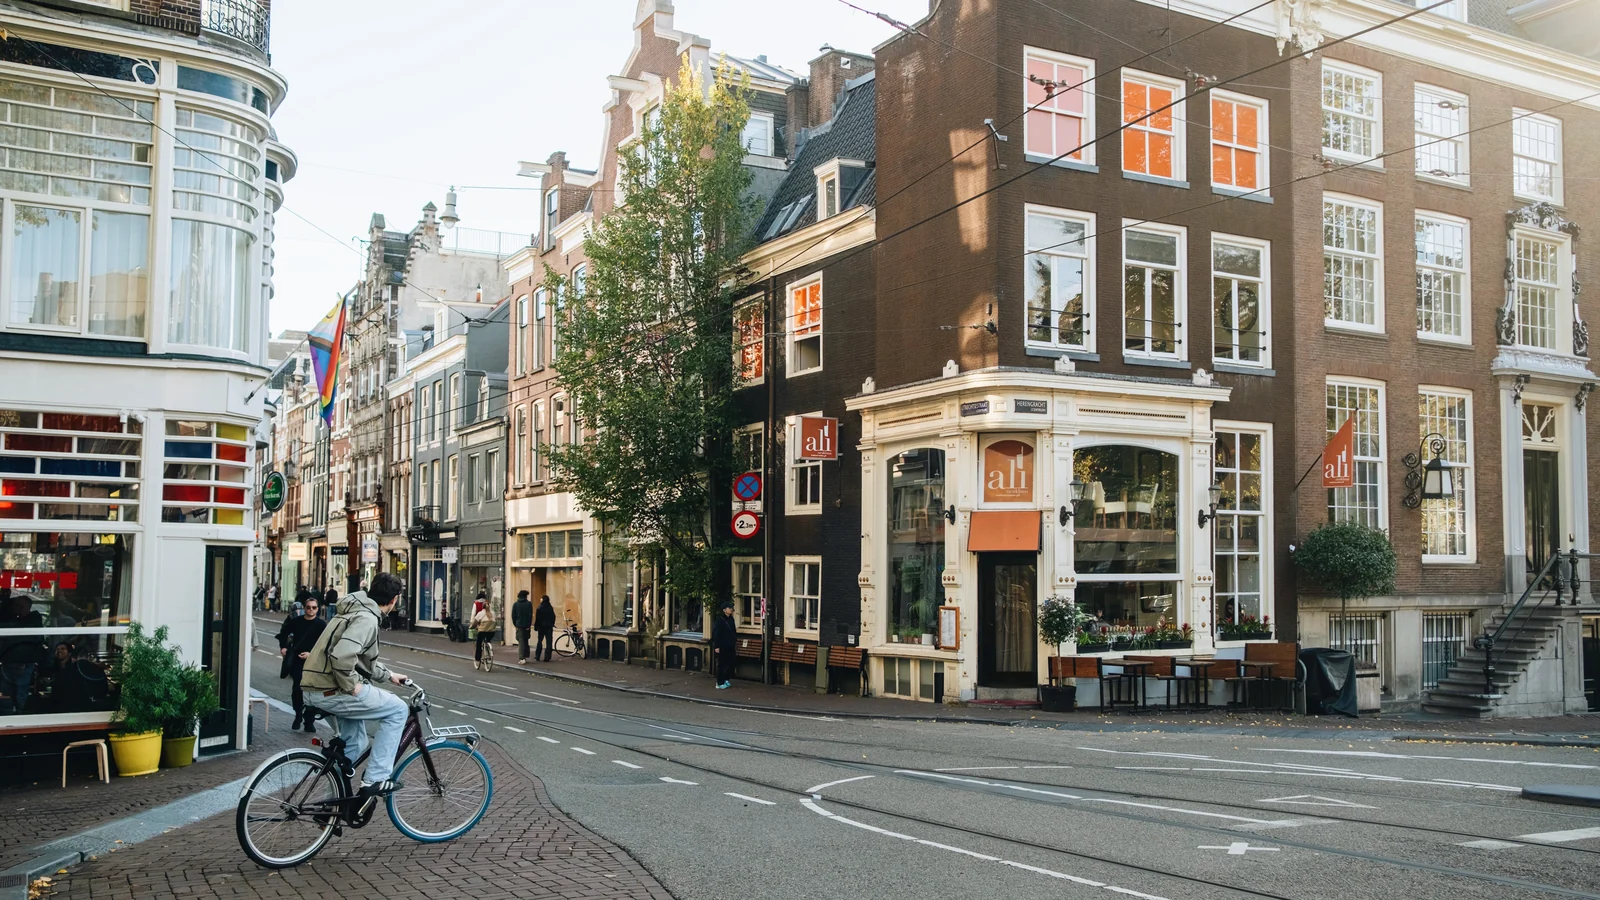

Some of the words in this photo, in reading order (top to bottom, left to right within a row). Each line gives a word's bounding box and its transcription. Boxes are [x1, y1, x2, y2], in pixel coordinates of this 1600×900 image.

[805, 423, 832, 452] ali
[987, 452, 1029, 490] ali
[1324, 450, 1350, 479] ali
